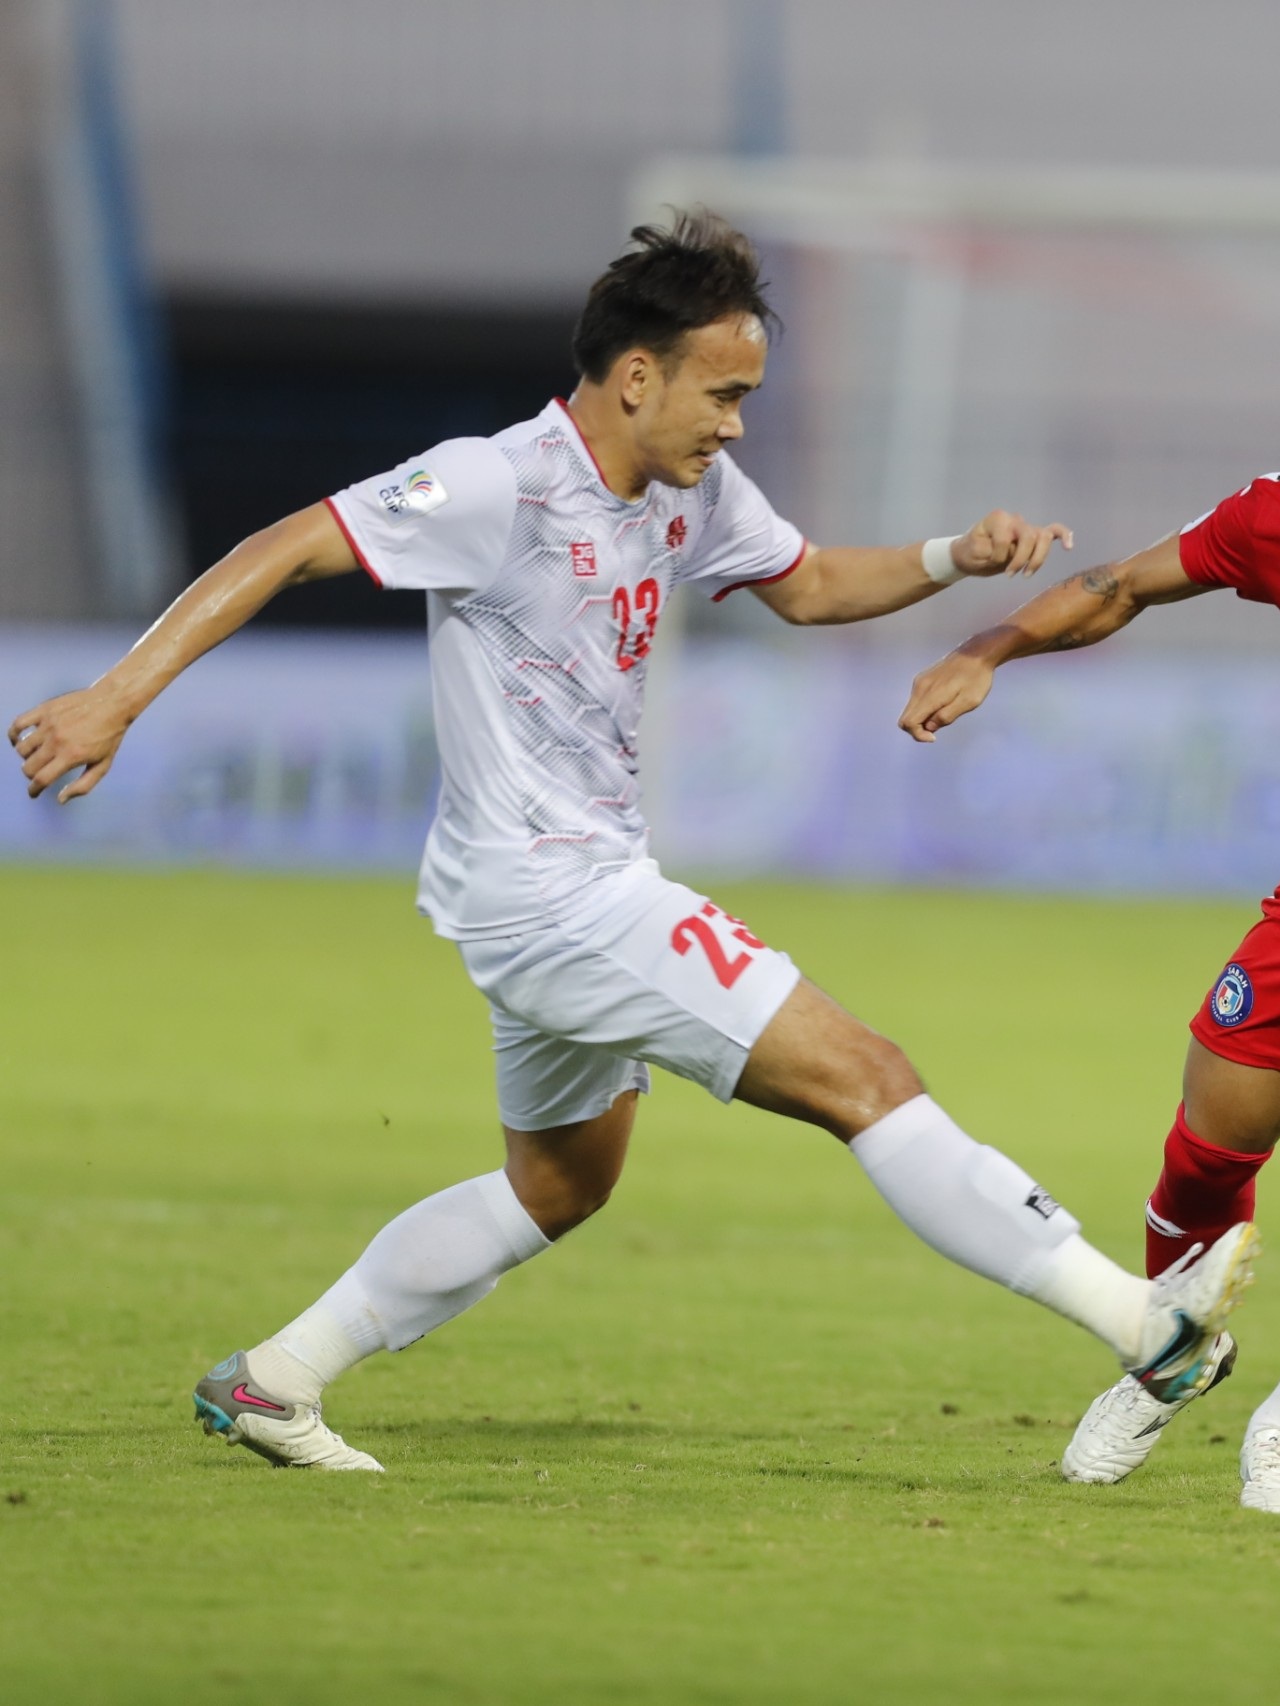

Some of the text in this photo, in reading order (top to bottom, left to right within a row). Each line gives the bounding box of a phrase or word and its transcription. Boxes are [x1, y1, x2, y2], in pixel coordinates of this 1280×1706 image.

[380, 489, 399, 513] CUP
[389, 485, 409, 509] AFC
[612, 577, 659, 672] 23
[1228, 967, 1248, 988] SABAH
